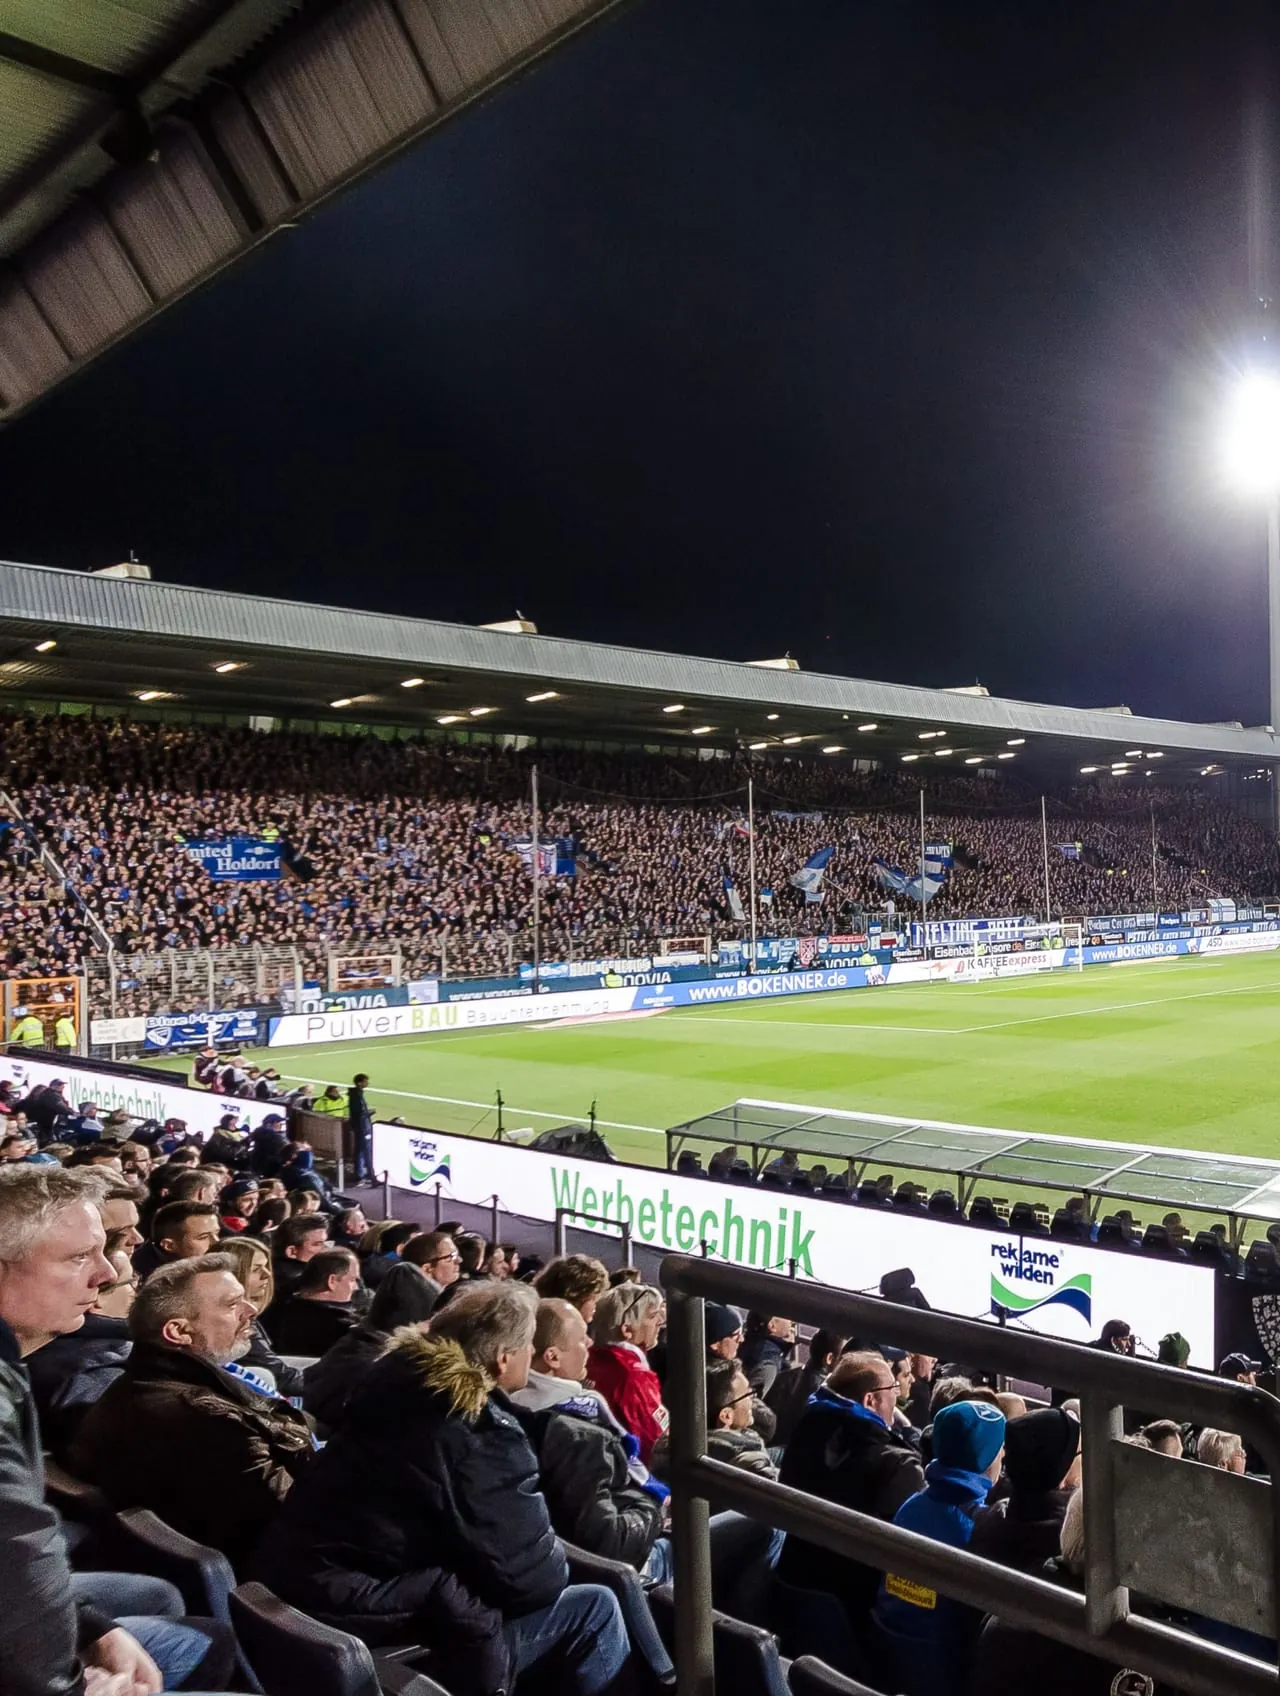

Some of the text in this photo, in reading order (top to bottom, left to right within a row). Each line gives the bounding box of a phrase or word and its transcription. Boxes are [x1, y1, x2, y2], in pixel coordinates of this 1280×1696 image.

[184, 844, 232, 858] nited
[216, 855, 280, 871] Holdorf
[1091, 944, 1178, 961] www.BOKENNER.de
[688, 972, 847, 1001] www.BOKENNER.de
[307, 1014, 403, 1040] Pulver
[411, 1006, 458, 1029] BAU
[69, 1076, 166, 1122] Werbetechnik
[550, 1166, 816, 1277] Werbetechnik
[991, 1239, 1059, 1268] reklame
[1000, 1260, 1054, 1286] wilden
